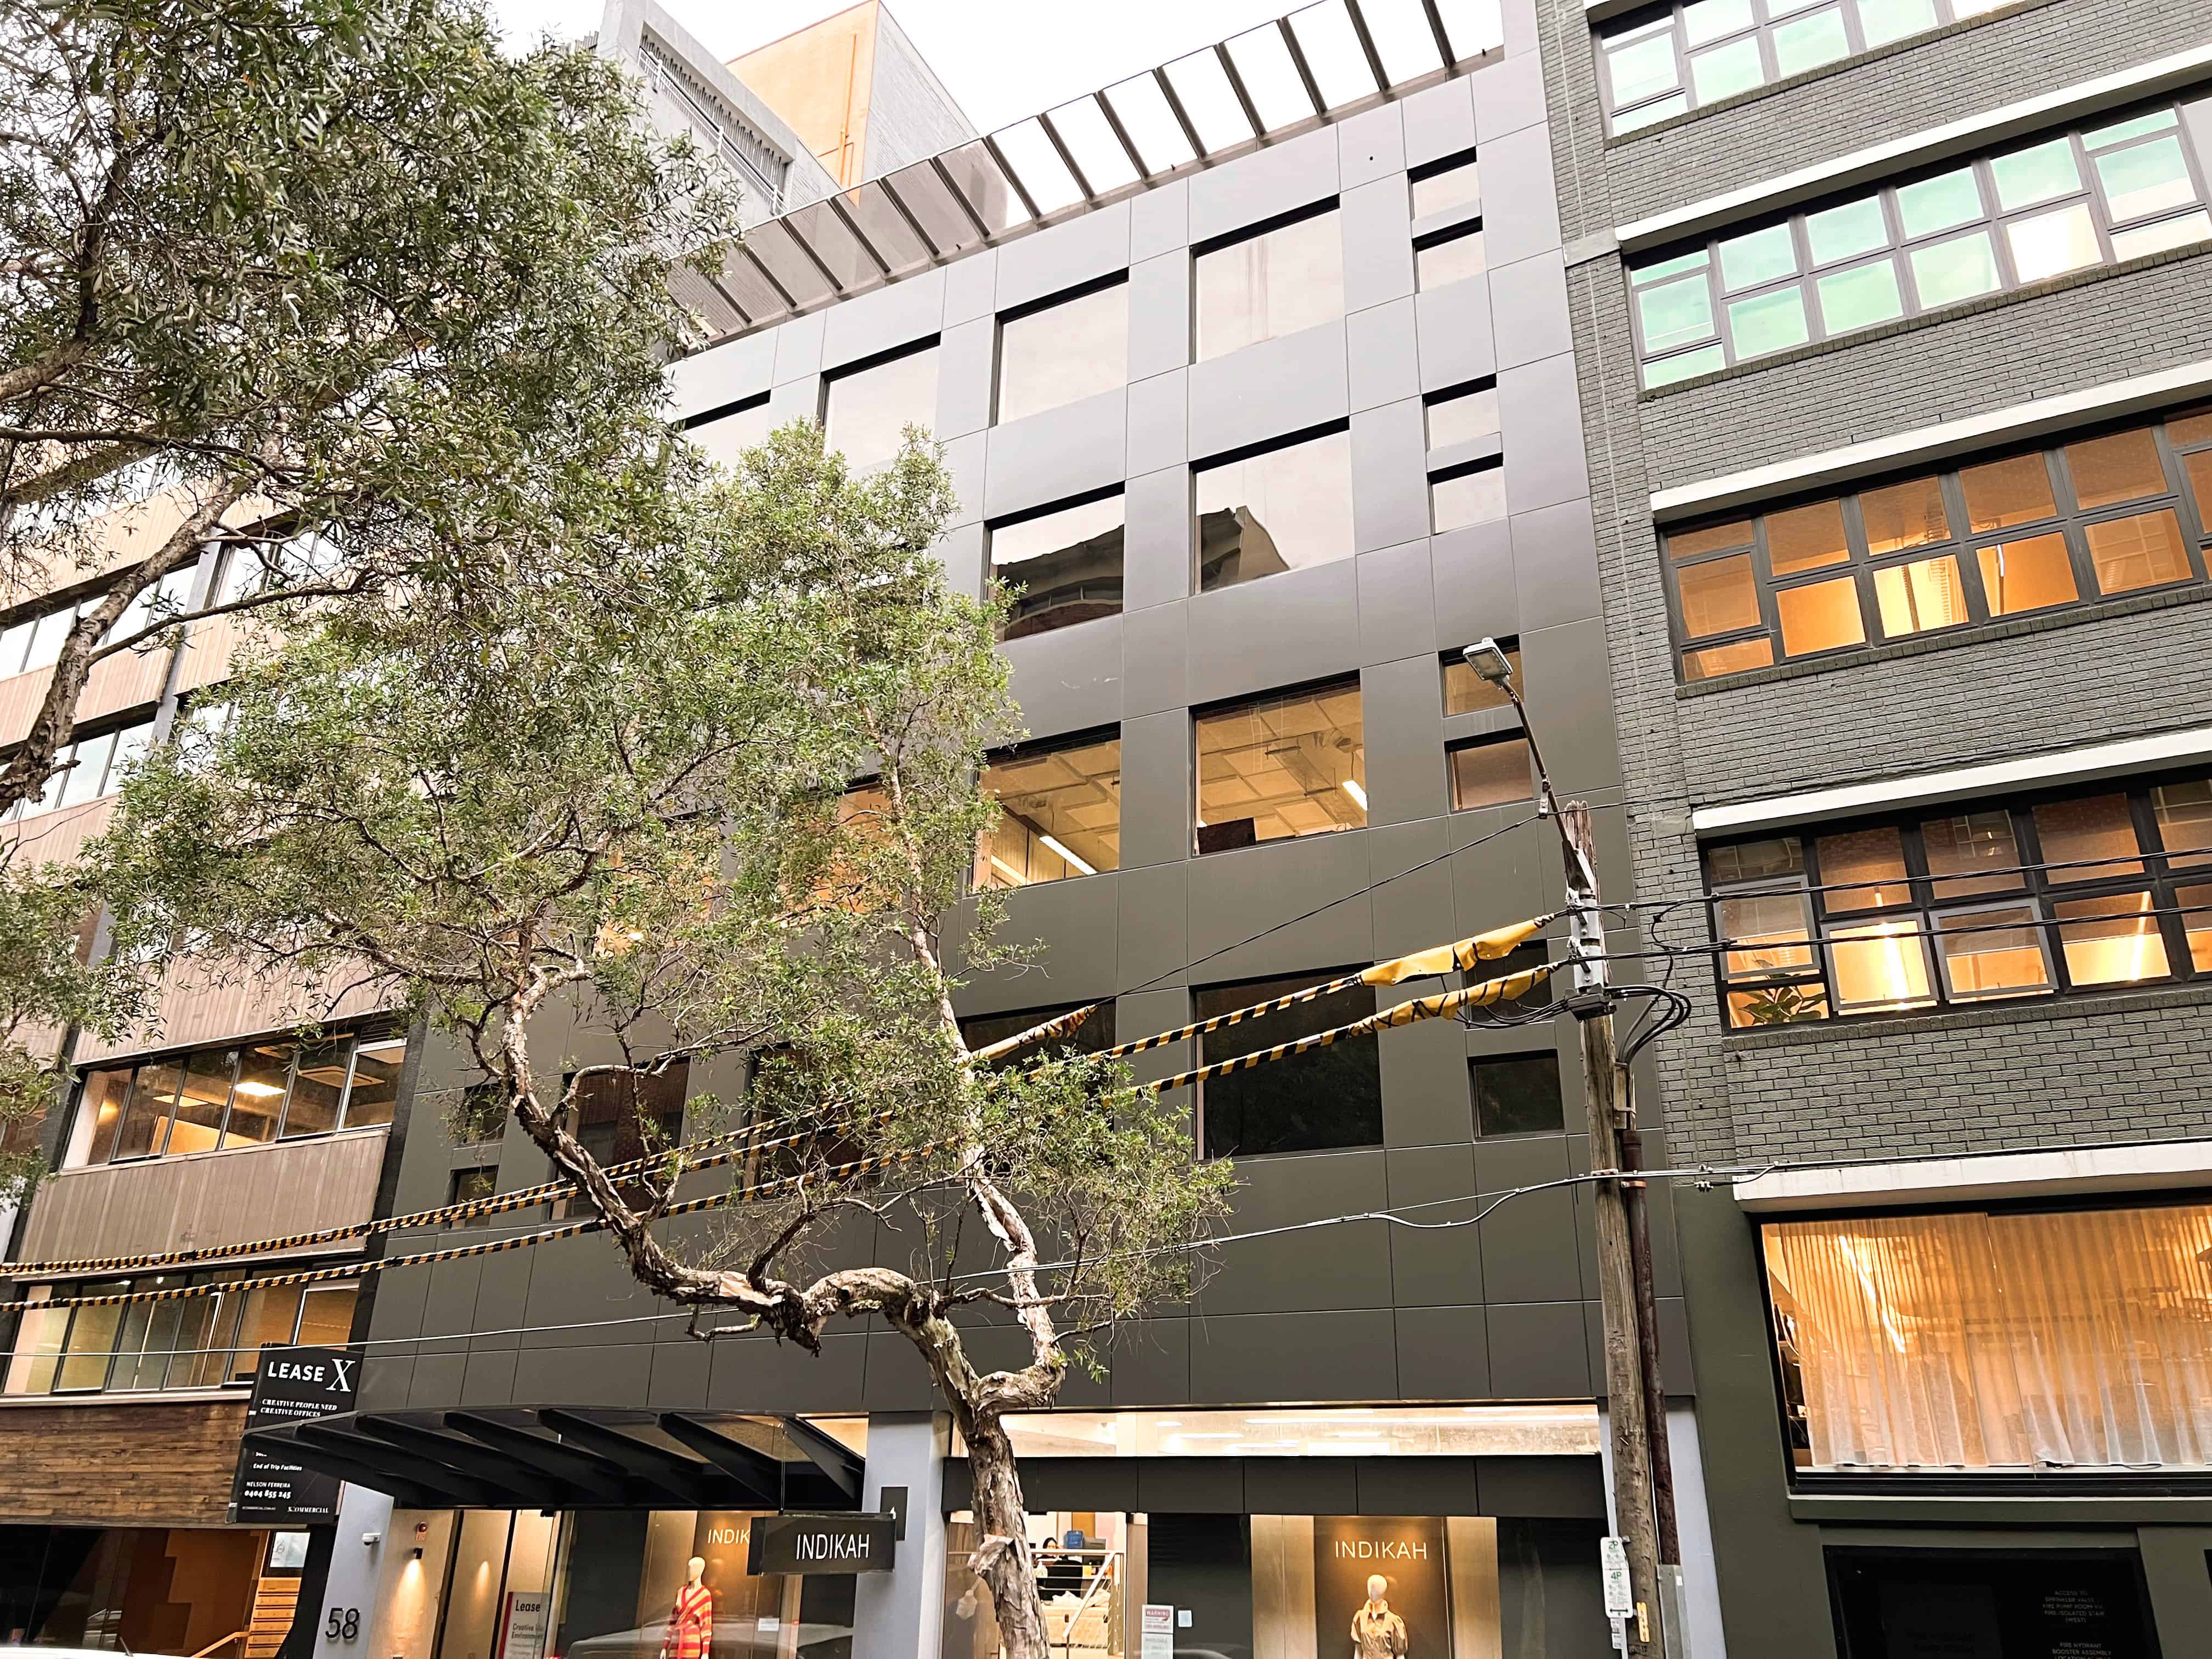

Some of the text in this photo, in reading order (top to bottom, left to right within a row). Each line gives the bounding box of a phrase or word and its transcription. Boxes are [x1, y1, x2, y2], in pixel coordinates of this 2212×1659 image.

[268, 1358, 356, 1392] LEASE X
[262, 1398, 295, 1407] CREATIVE
[295, 1401, 320, 1409] PEOPLE
[260, 1407, 294, 1415] CREATIVE
[264, 1489, 277, 1499] 855
[708, 1528, 751, 1544] INDIK
[796, 1533, 870, 1560] INDIKAH
[1335, 1541, 1427, 1560] INDIKAH
[1608, 1540, 1619, 1550] 2P
[1610, 1571, 1622, 1580] 4P
[515, 1599, 540, 1612] Lease
[325, 1608, 360, 1639] 58
